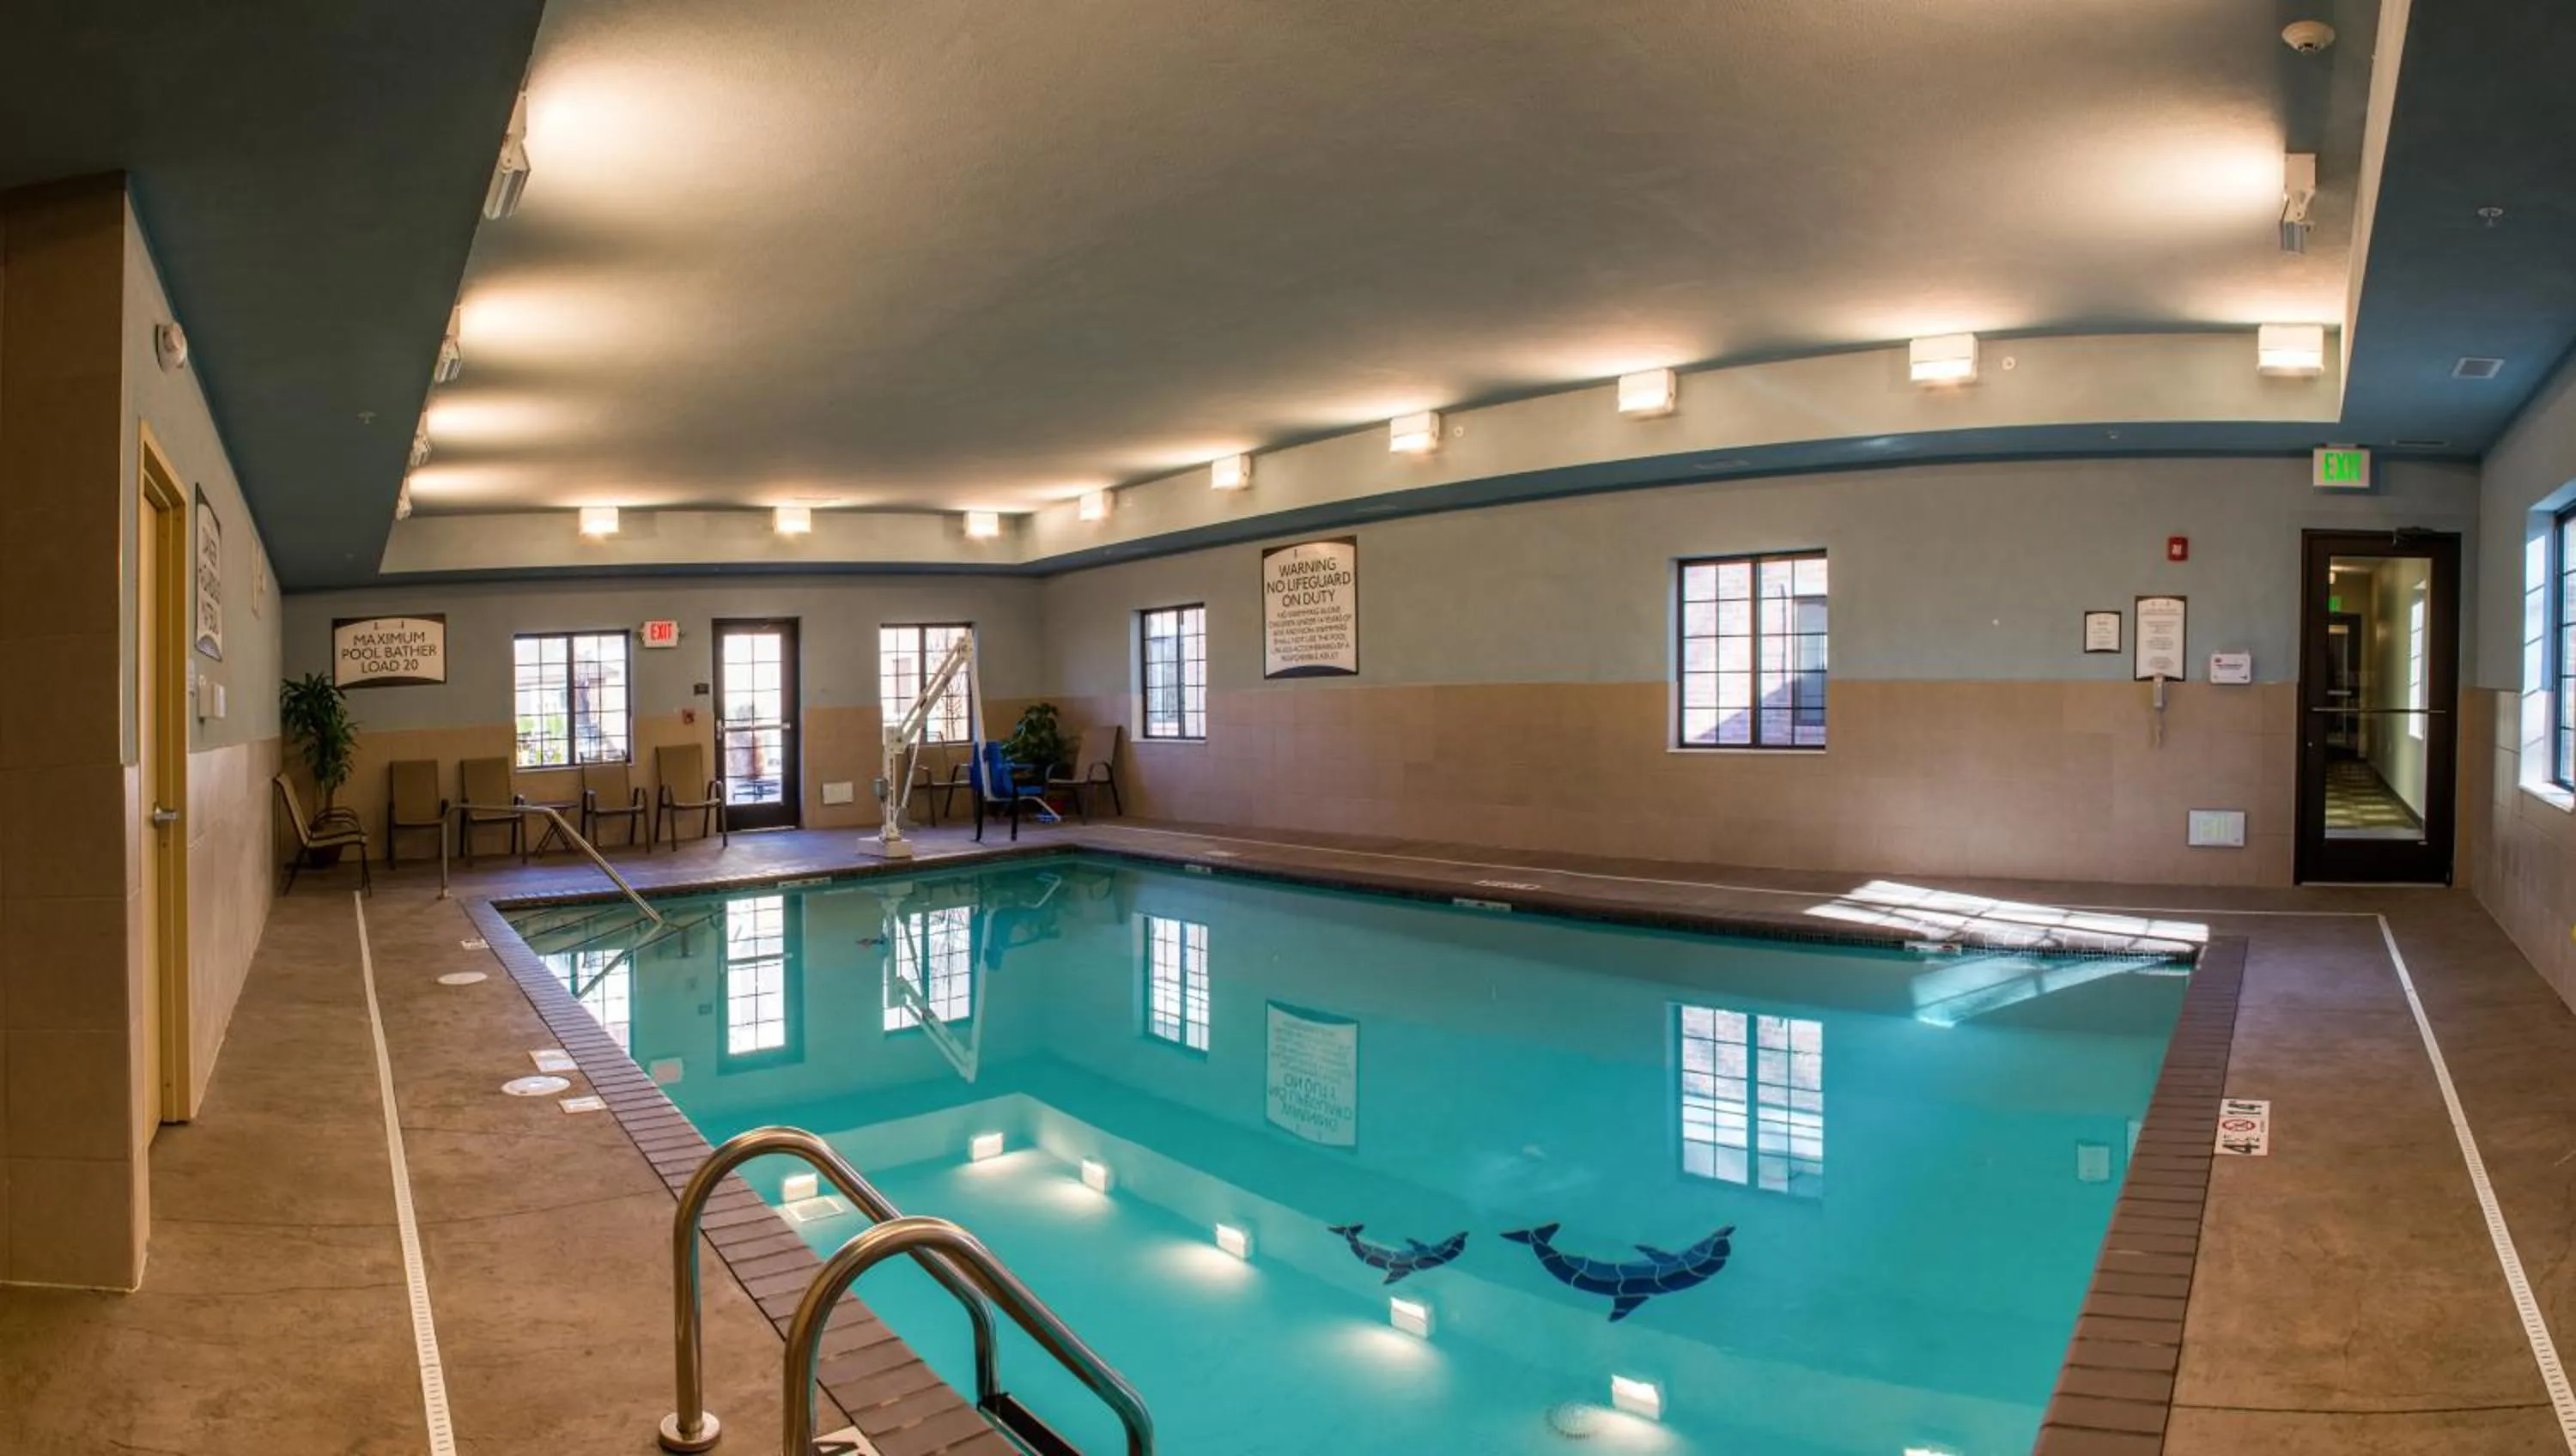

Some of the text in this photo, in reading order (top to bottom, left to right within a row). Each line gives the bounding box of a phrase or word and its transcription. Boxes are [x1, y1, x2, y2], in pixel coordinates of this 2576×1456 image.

[2324, 452, 2361, 482] EXIT
[1279, 556, 1337, 577] WARNING
[1267, 571, 1352, 594] NO LIFEGUARD
[1282, 589, 1335, 608] ON DUTY
[353, 631, 425, 646] MAXIMUM
[650, 623, 672, 640] EXIT
[342, 645, 437, 660] POOL BATHER
[361, 658, 419, 674] LOAD 20
